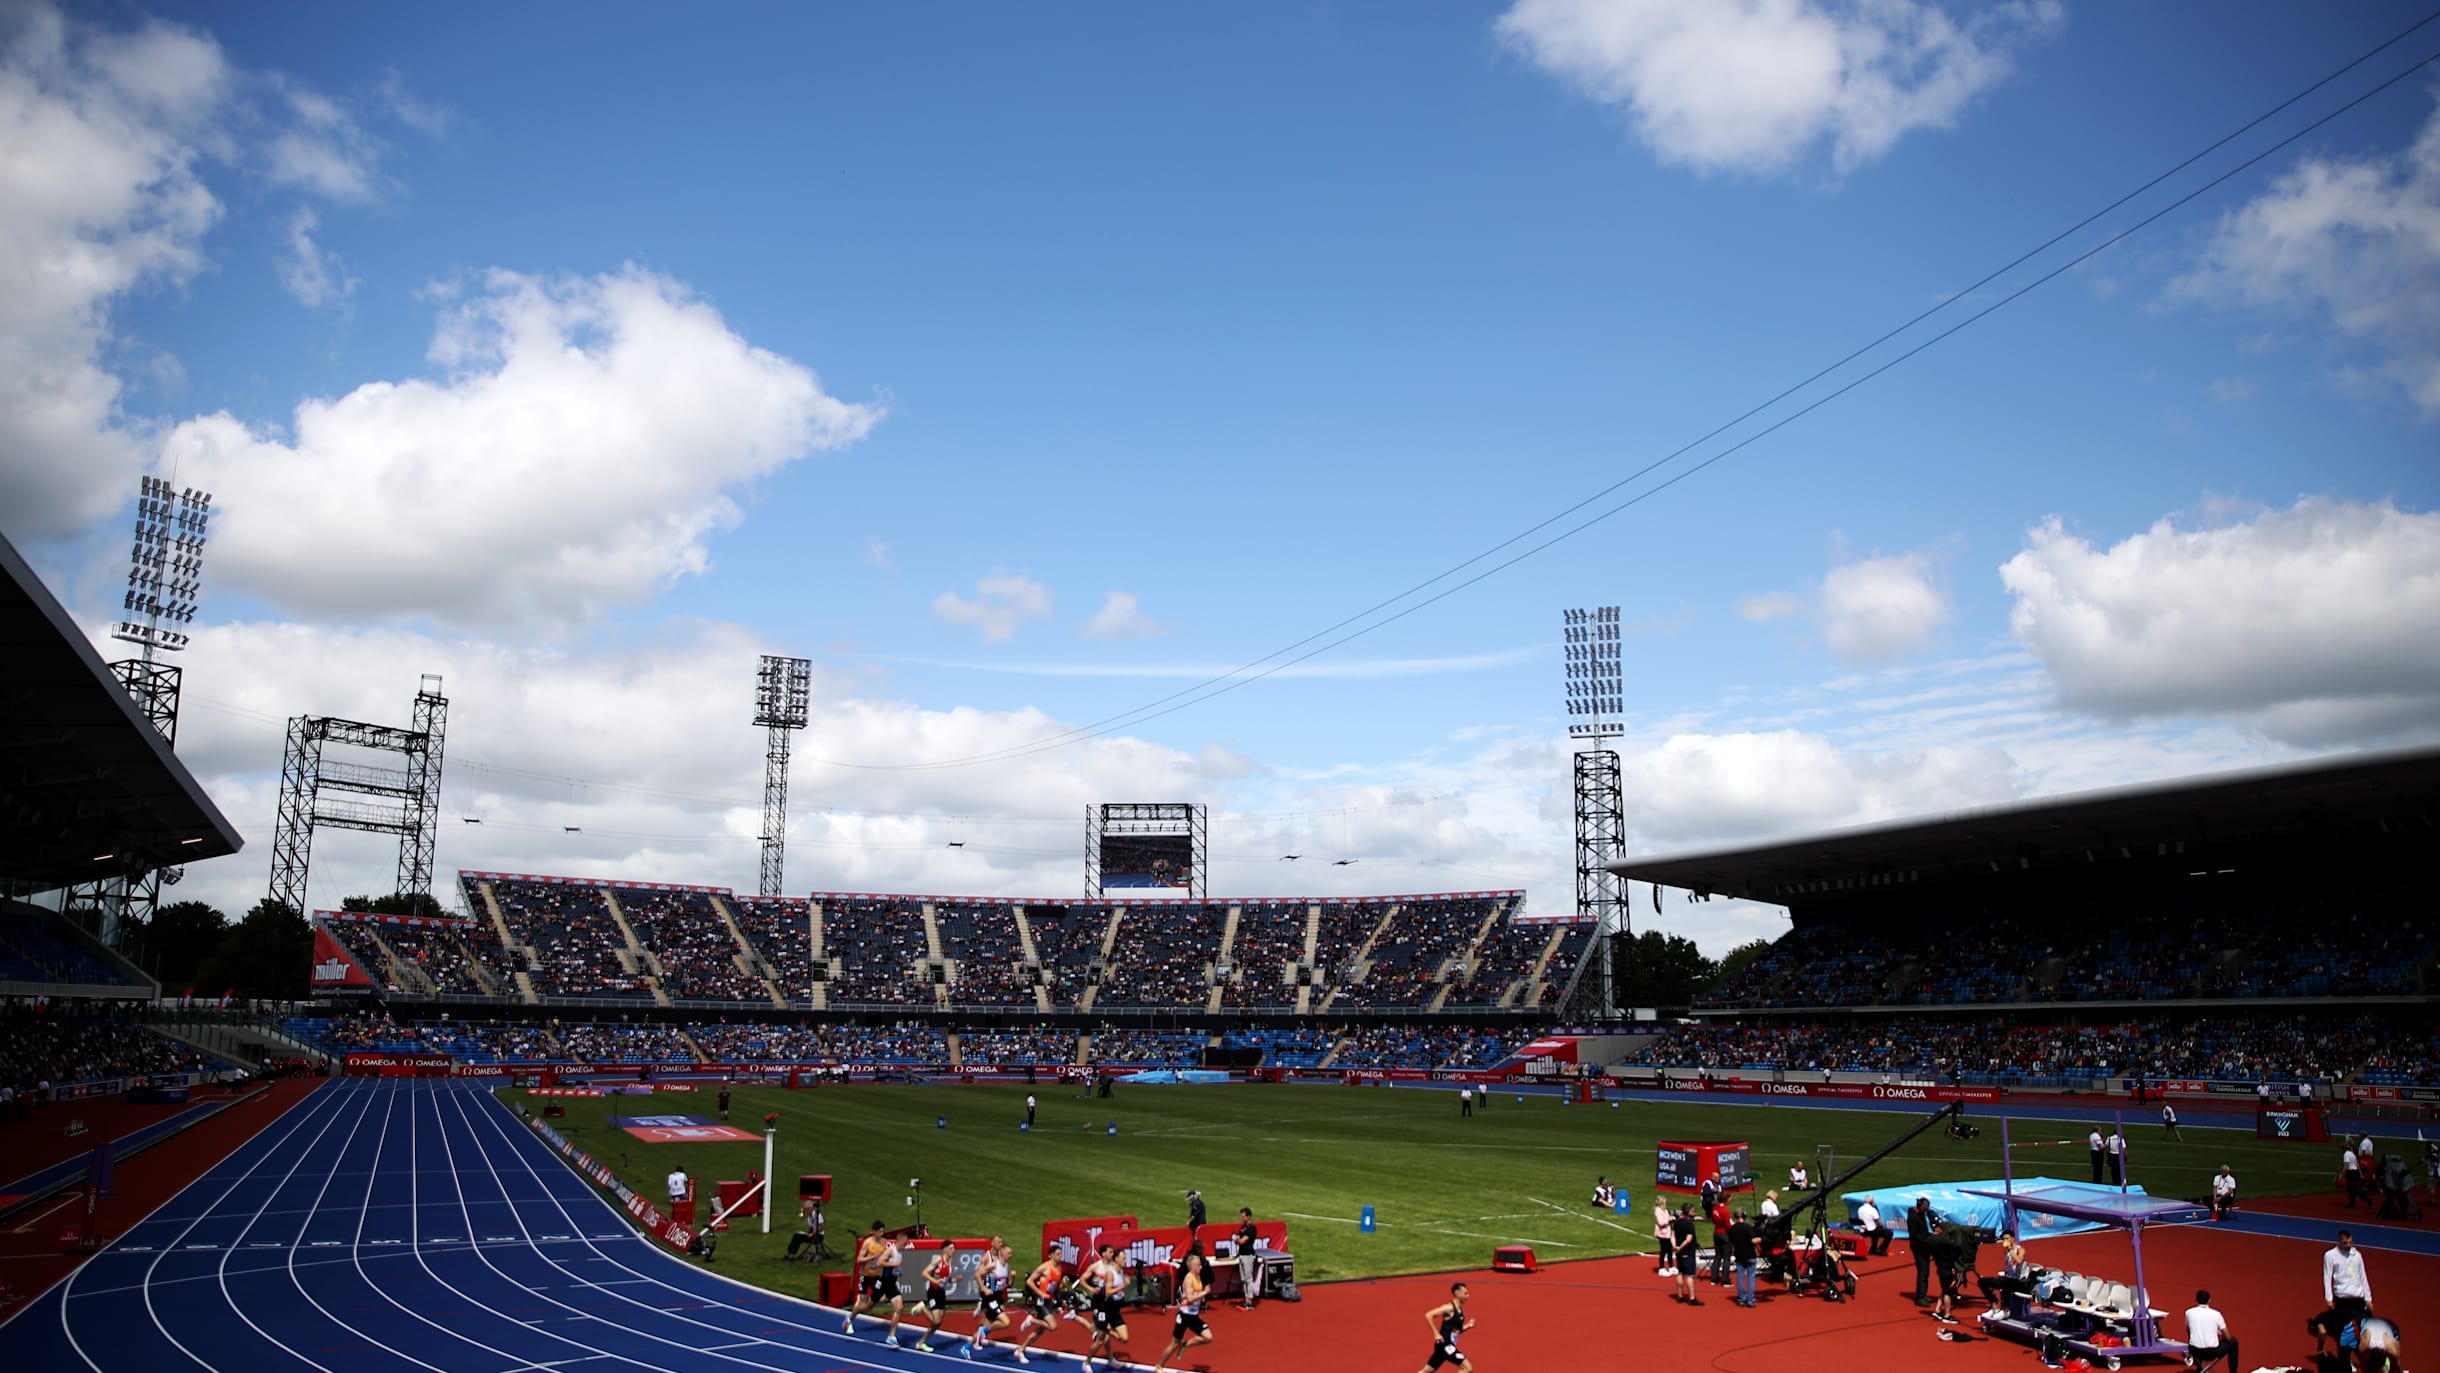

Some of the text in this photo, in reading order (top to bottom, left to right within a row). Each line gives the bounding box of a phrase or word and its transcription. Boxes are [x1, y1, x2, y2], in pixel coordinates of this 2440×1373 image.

[315, 957, 350, 981] müller
[362, 1058, 397, 1066] OMEGA
[416, 1059, 450, 1067] OMEGA
[474, 1067, 503, 1076] OMEGA
[661, 1065, 691, 1073] OMEGA
[1675, 1080, 1705, 1090] OMEGA
[1773, 1084, 1807, 1095] OMEGA
[1887, 1088, 1927, 1099] OMEGA
[1659, 1162, 1669, 1170] USA
[671, 1227, 691, 1249] OMEGA
